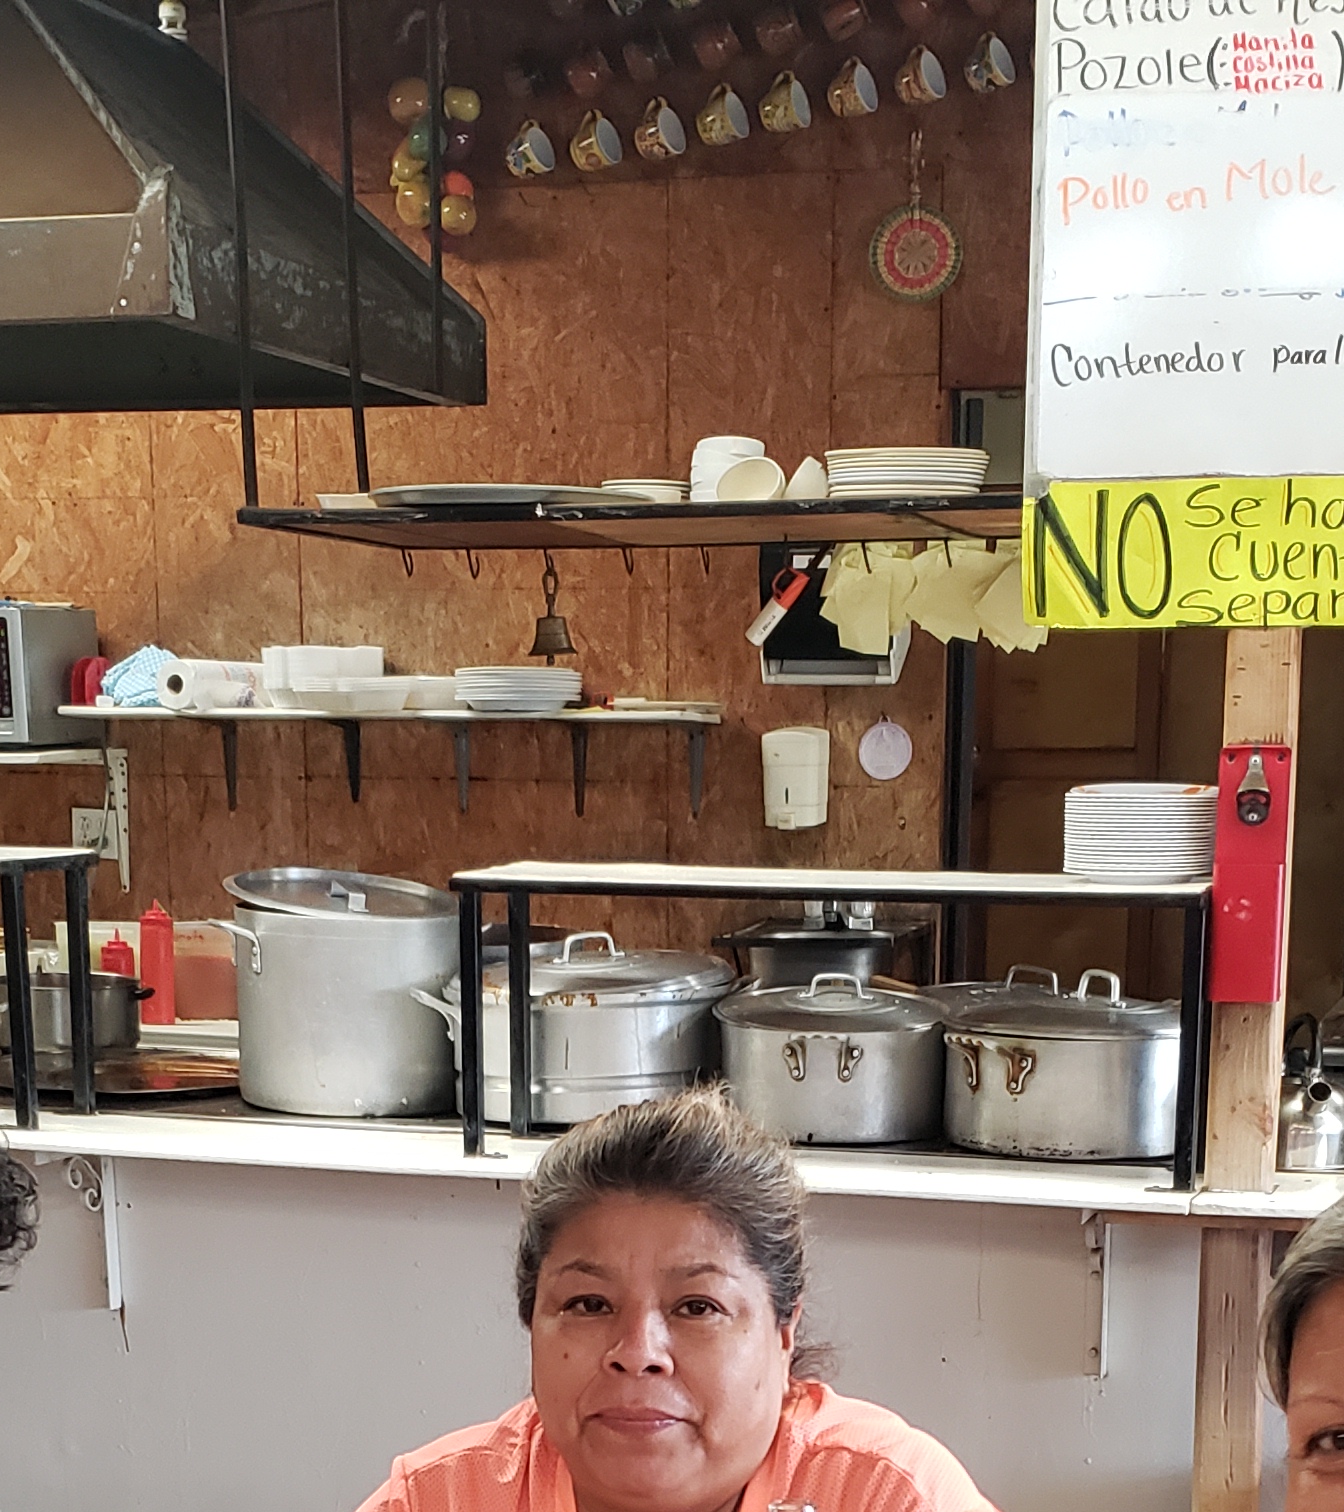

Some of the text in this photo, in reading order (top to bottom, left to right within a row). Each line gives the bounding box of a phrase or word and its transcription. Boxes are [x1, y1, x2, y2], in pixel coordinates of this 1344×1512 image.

[1057, 172, 1149, 226] Pollo
[1166, 186, 1208, 212] en
[1225, 152, 1336, 202] Mole
[1050, 341, 1246, 387] Contenedor
[1034, 487, 1173, 619] NO
